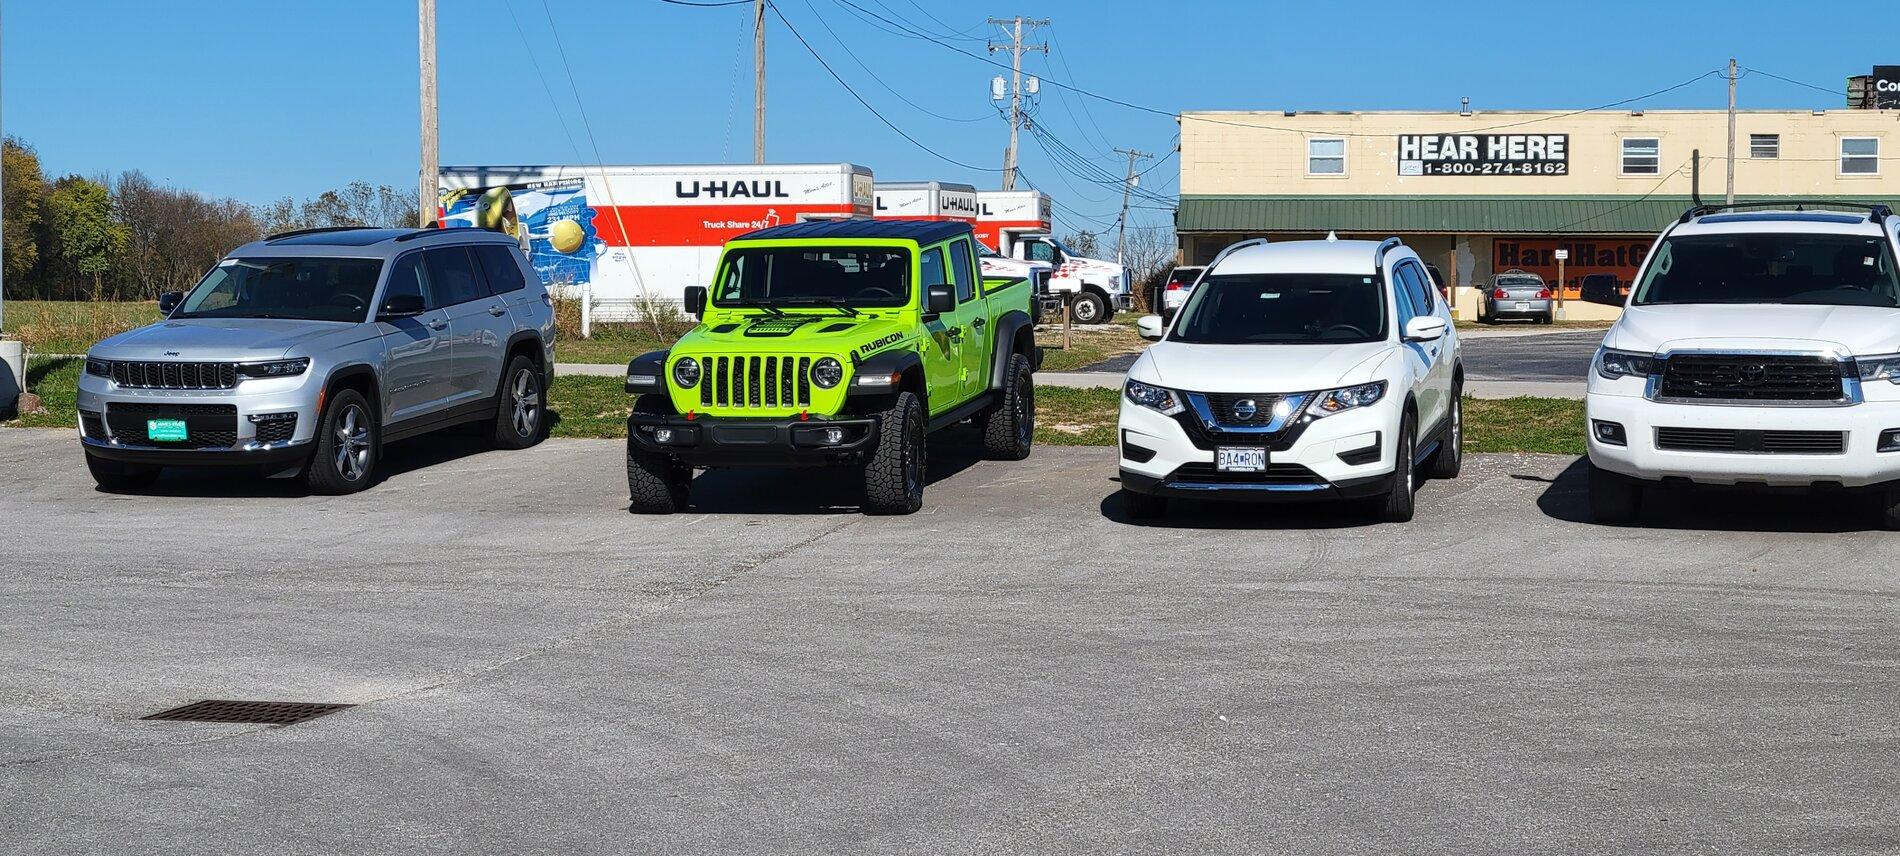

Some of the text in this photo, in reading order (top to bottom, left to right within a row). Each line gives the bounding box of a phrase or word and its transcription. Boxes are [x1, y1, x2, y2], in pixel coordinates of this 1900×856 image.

[1401, 136, 1565, 160] HEAR HERE
[1424, 163, 1566, 174] 1-800-274-8162
[676, 180, 789, 198] U-HAUL
[942, 196, 975, 212] U-HAUL
[703, 219, 769, 229] Truck Share 24/7
[860, 331, 903, 353] RUBICON
